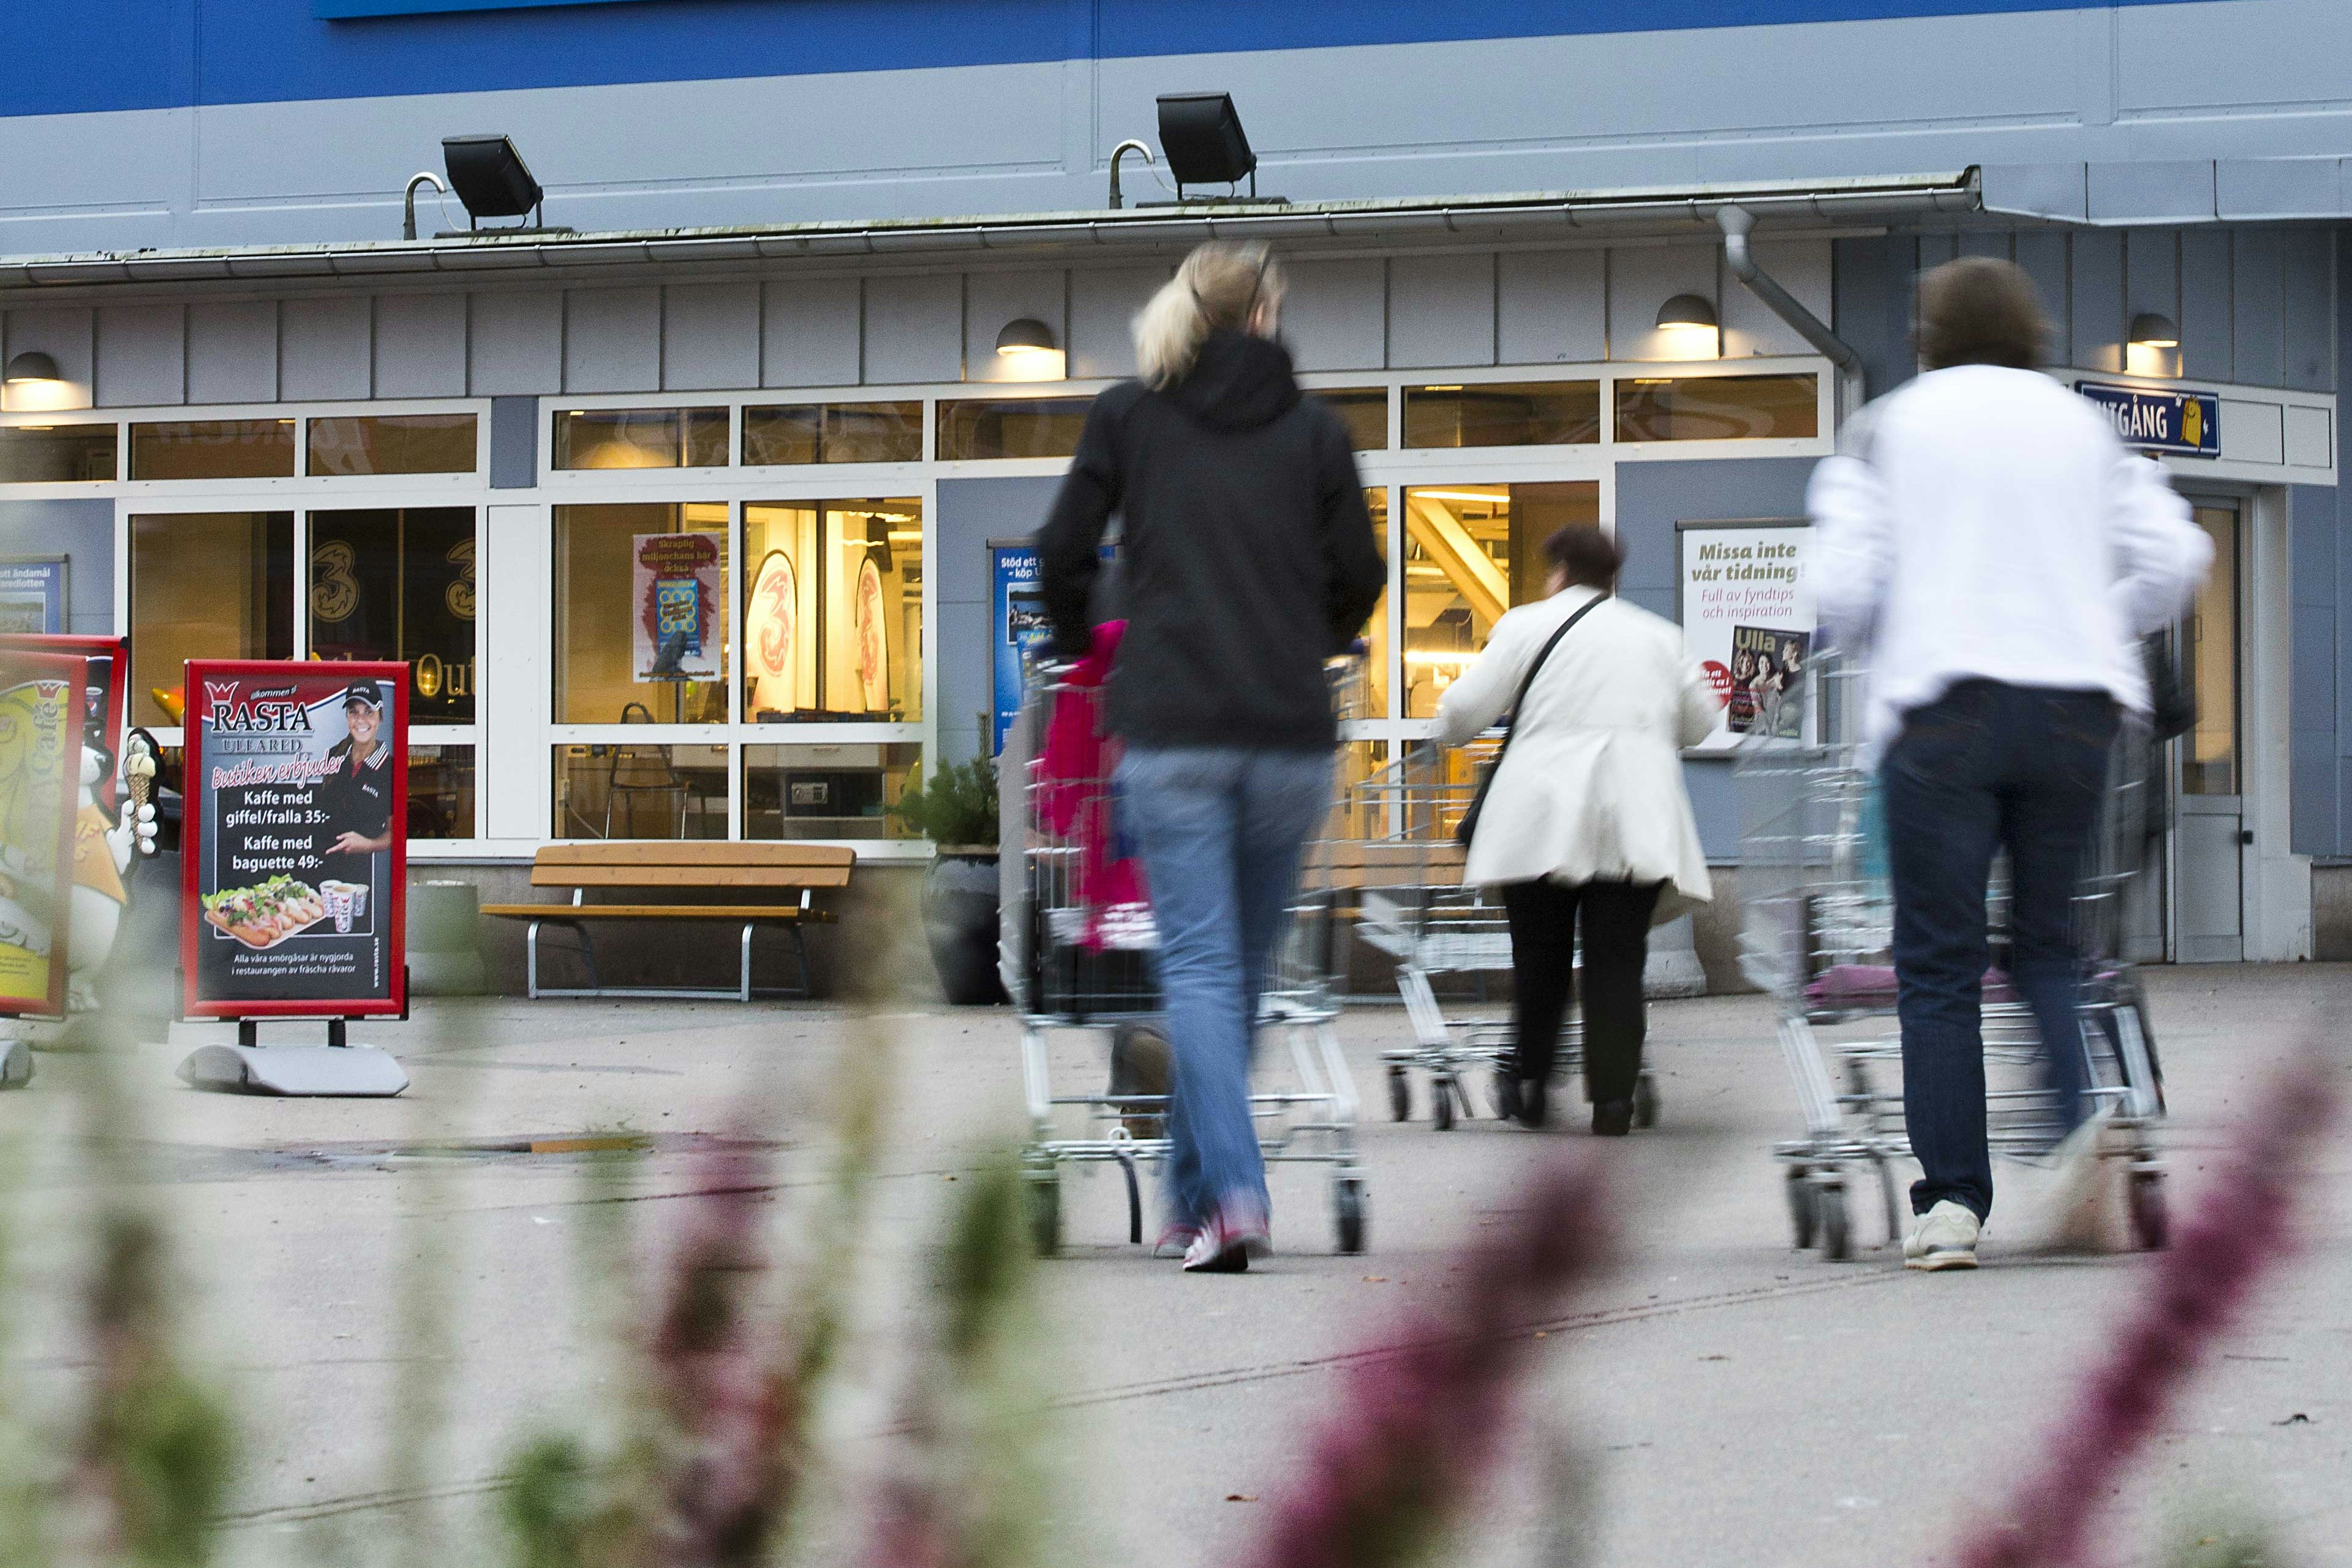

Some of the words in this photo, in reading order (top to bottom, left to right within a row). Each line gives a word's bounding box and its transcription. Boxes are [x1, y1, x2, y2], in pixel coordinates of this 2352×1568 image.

[1699, 543, 1752, 560] Missa
[1757, 541, 1796, 559] inte
[1001, 557, 1021, 568] Stöd
[1023, 557, 1037, 567] ett
[13, 568, 50, 578] ändamål
[1016, 568, 1032, 579] köp
[1692, 564, 1722, 581] vår
[312, 540, 360, 622] 3
[1702, 588, 1722, 602] Full
[1726, 591, 1740, 600] av
[1744, 587, 1793, 604] fyndtips
[1703, 606, 1723, 619] och
[1728, 605, 1792, 620] inspiration
[1736, 628, 1776, 652] Ulla
[211, 702, 314, 733] RASTA
[223, 739, 303, 753] ULLARED
[212, 757, 277, 790] Butiken
[278, 750, 346, 790] erbjuder
[244, 790, 280, 805] Kaffe
[283, 790, 313, 805] med
[226, 809, 301, 828] giffel/fralla
[304, 810, 330, 824] 35:-
[244, 835, 279, 851] Kaffe
[283, 835, 312, 850] med
[233, 855, 295, 873] baguette
[298, 854, 323, 870] 49:-
[234, 954, 249, 963] Alla
[251, 954, 267, 963] våra
[269, 953, 308, 964] smörgåsar
[310, 952, 318, 962] är
[320, 952, 353, 963] nygjorda
[236, 966, 287, 977] restaurangen
[300, 965, 327, 974] fräscha
[328, 965, 356, 973] råvaror
